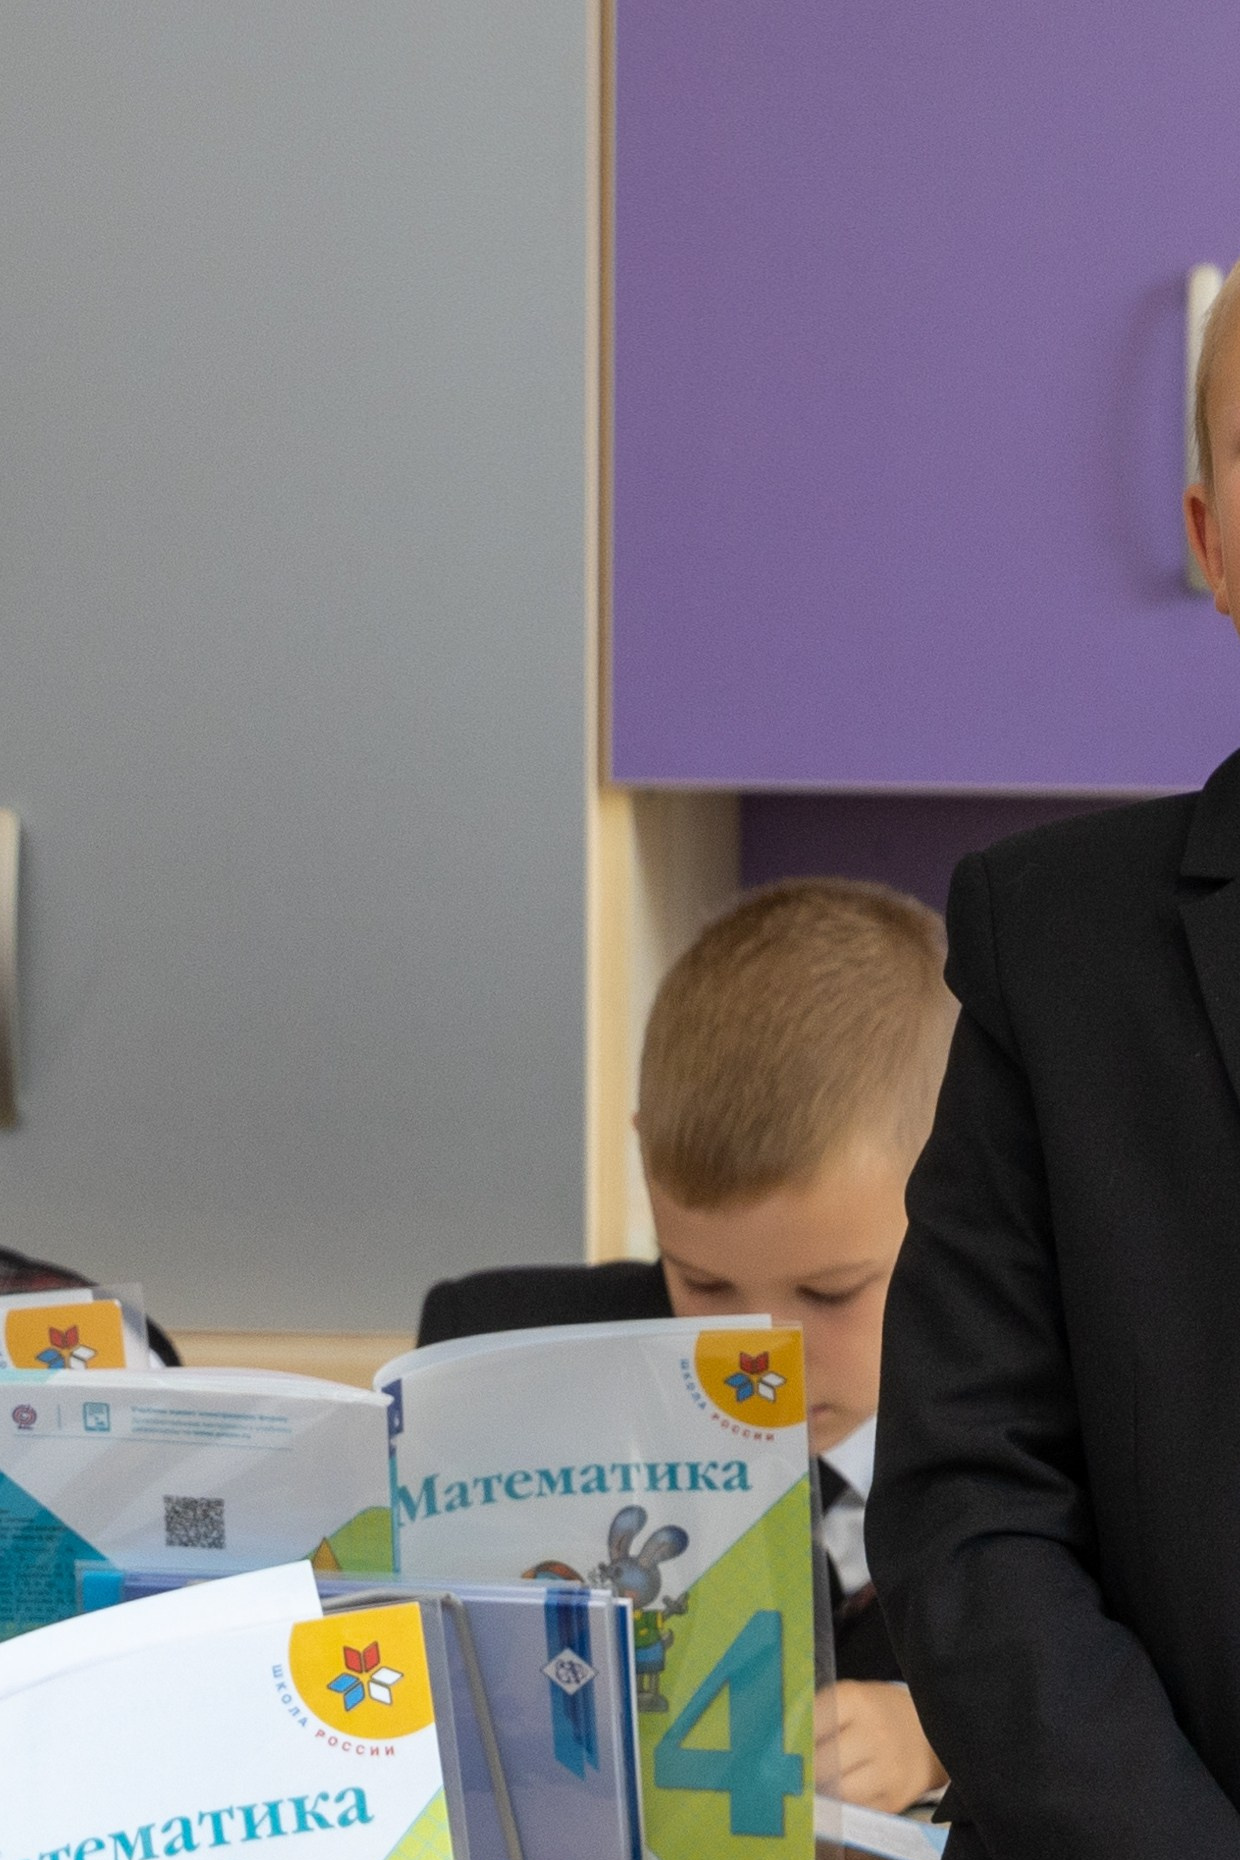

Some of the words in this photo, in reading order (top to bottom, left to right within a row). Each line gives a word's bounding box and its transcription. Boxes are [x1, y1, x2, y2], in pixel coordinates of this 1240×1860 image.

[396, 1459, 753, 1526] Математика
[272, 1664, 308, 1727] ШКОЛА
[315, 1729, 395, 1756] РОССИИ
[654, 1609, 804, 1837] 4
